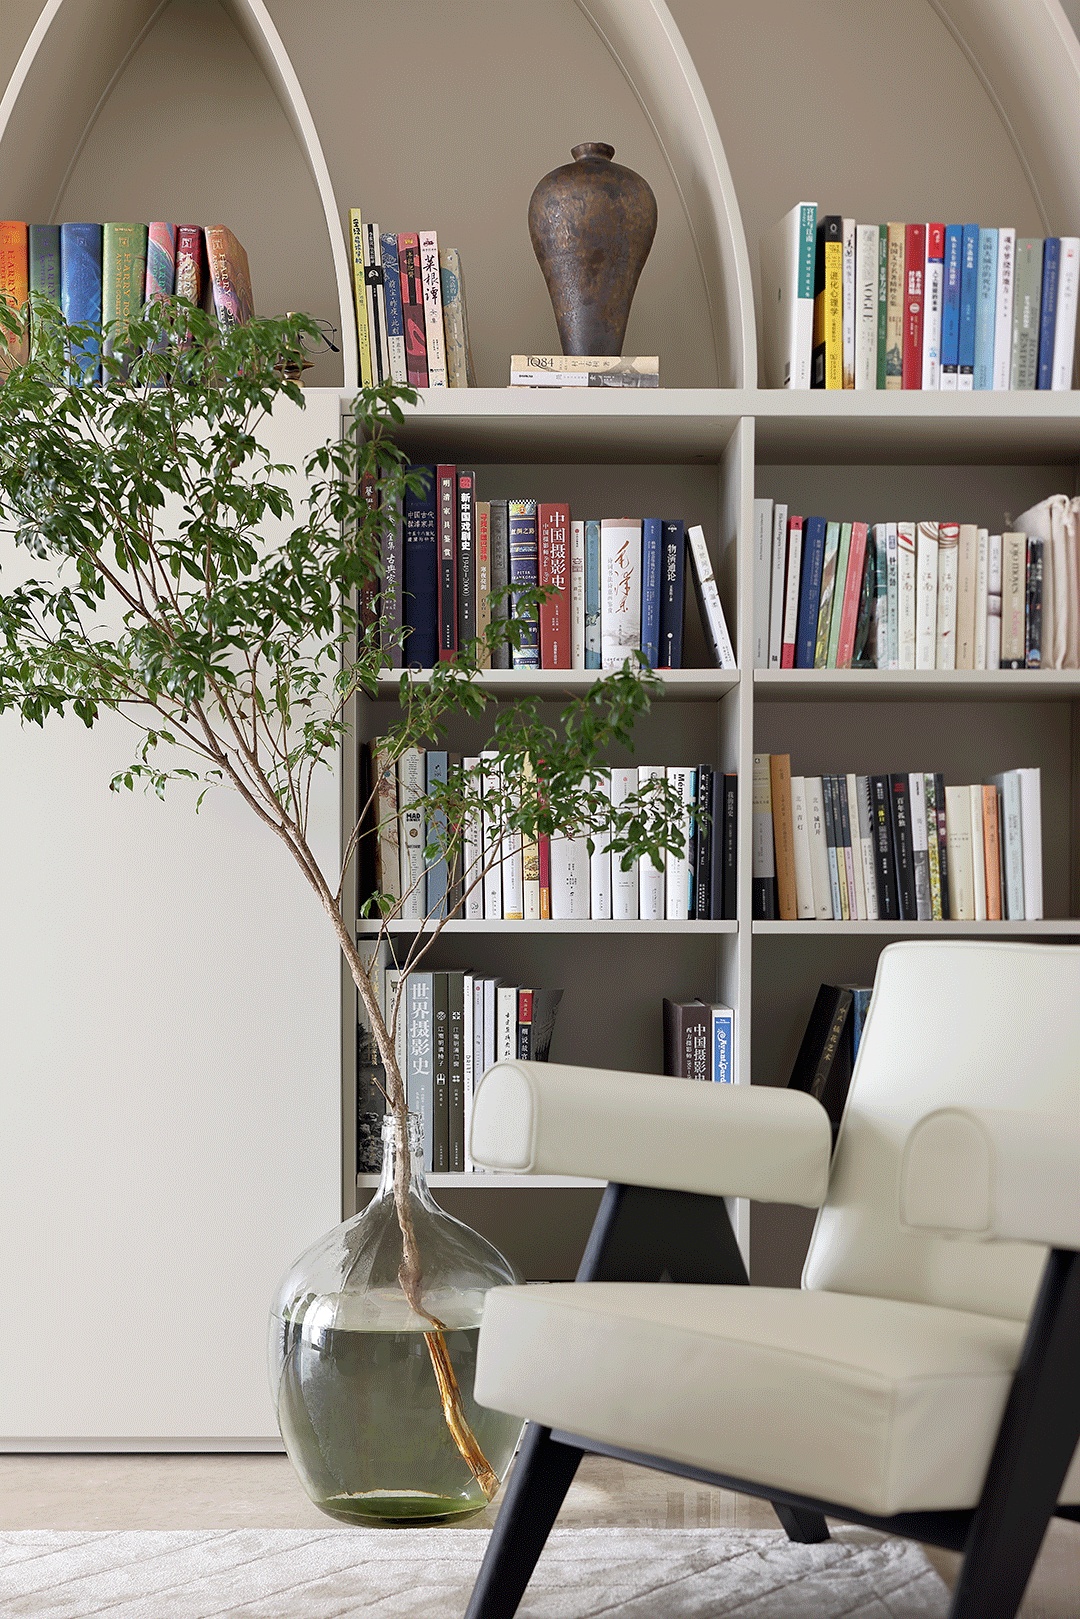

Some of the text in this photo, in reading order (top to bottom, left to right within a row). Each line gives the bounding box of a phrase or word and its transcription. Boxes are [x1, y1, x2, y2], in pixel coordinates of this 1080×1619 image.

[123, 253, 132, 297] HARRY
[219, 253, 231, 297] HARRY
[423, 254, 439, 305] 菜根谭
[830, 271, 839, 316] 进化心理学
[863, 283, 874, 322] VOGUE
[460, 493, 471, 550] 新中国戏剧史
[550, 512, 566, 590] 中国摄影史
[667, 544, 677, 582] 物演通论
[615, 540, 634, 614] 毛泽东
[410, 983, 430, 1076] 世界摄影史
